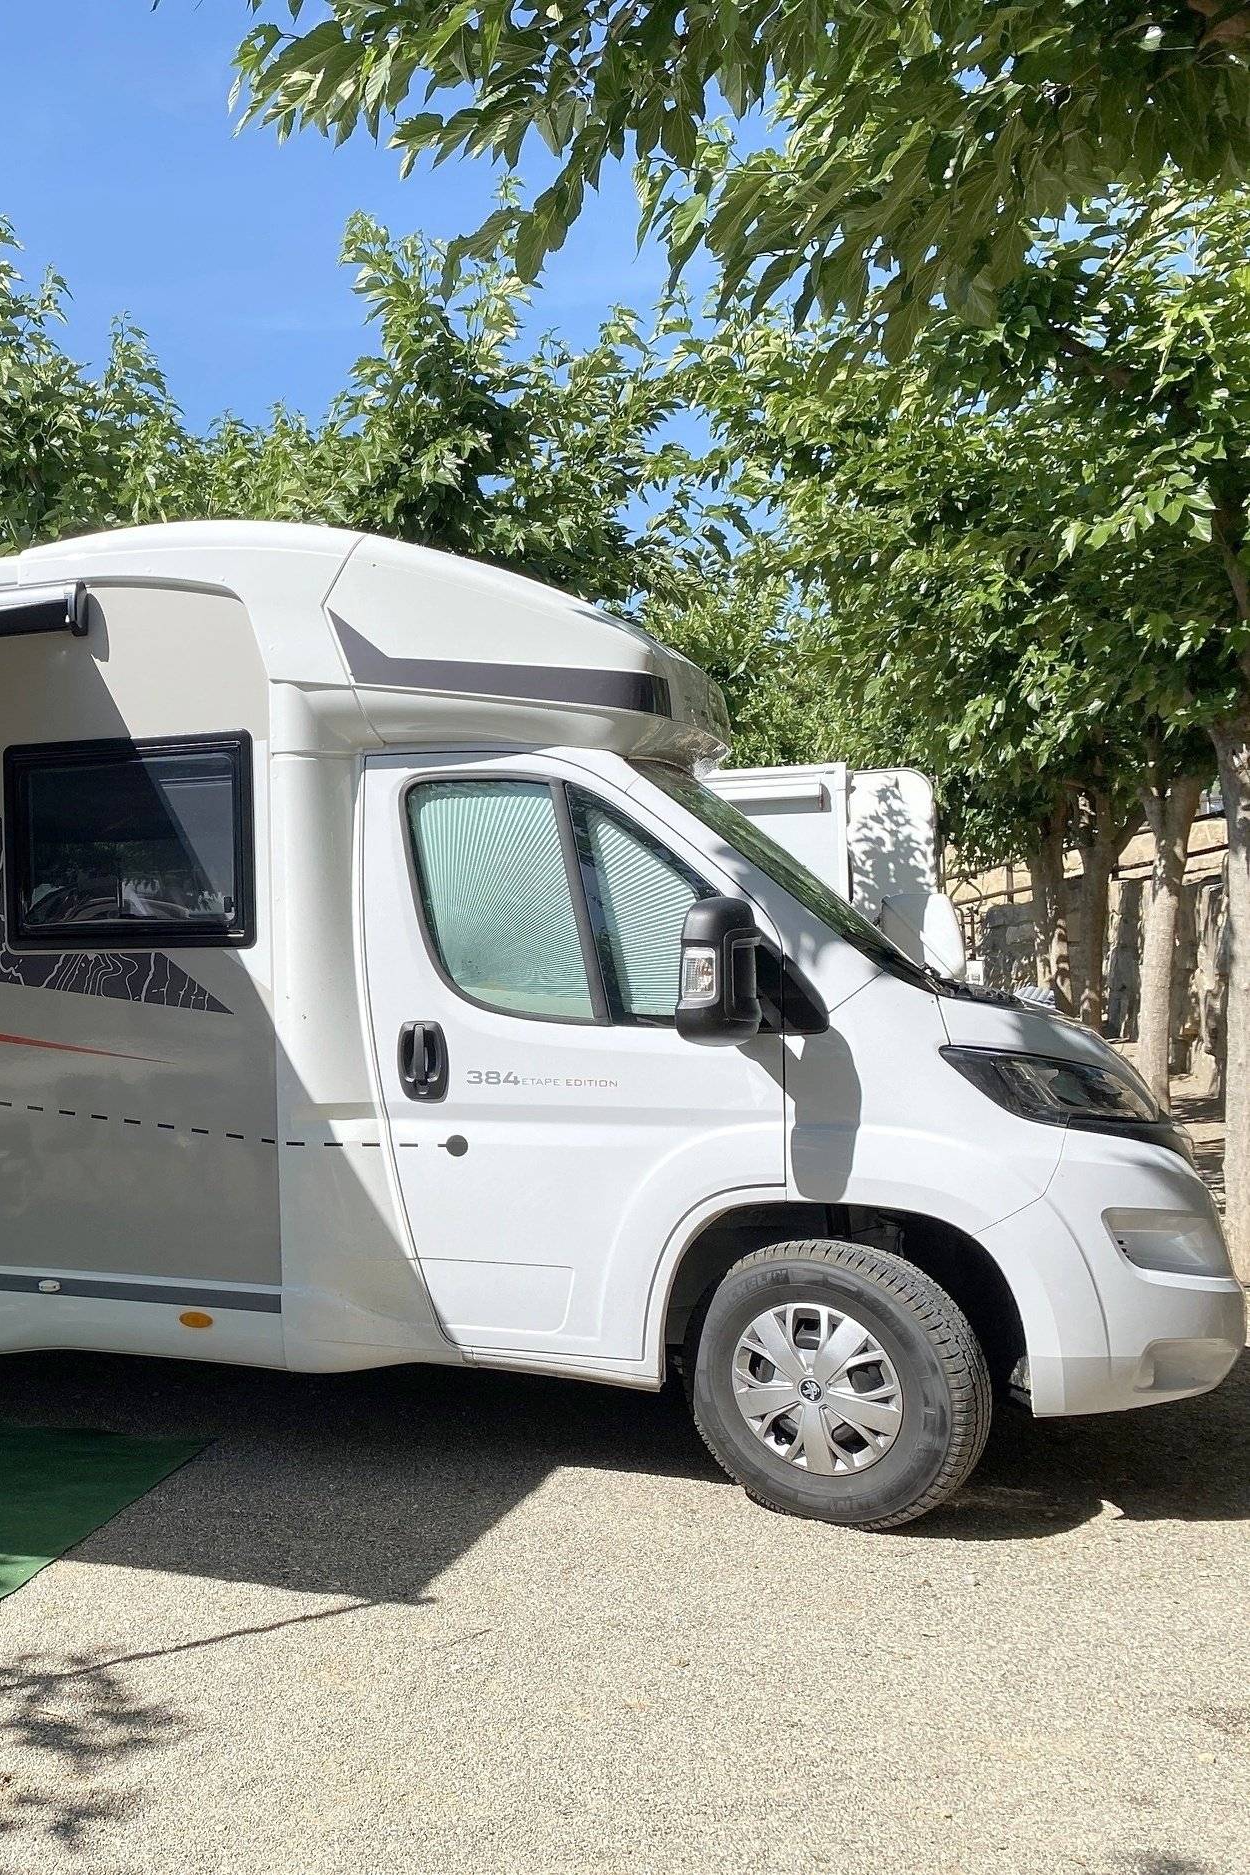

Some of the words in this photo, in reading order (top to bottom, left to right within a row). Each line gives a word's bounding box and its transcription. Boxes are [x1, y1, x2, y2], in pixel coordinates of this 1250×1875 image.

[466, 1070, 520, 1086] 384
[521, 1077, 561, 1087] ETAPE
[565, 1078, 618, 1088] EDITION
